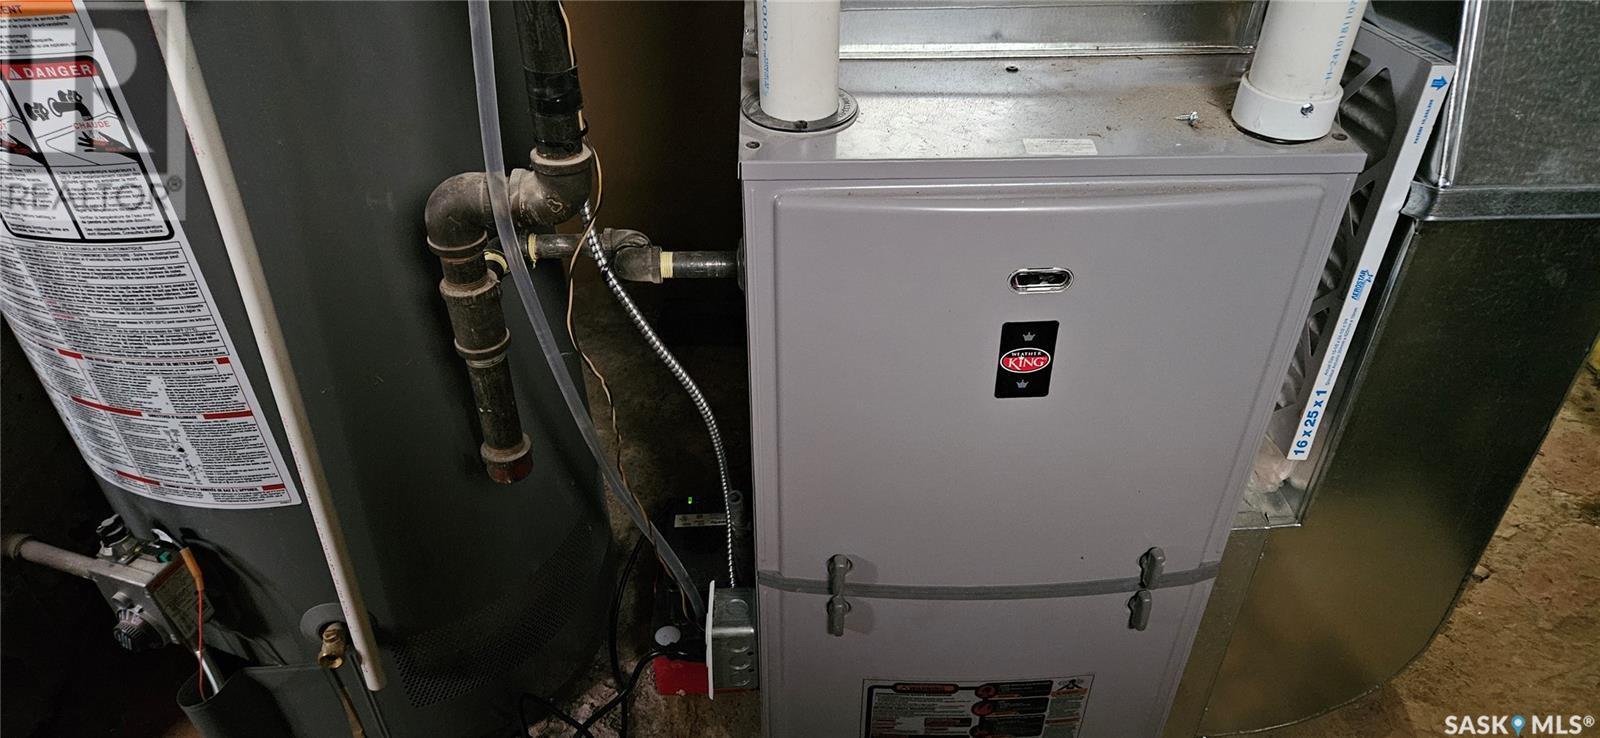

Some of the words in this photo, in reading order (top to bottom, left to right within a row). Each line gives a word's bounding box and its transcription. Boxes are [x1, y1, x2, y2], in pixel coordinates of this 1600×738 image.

[24, 64, 92, 79] DANGER
[73, 120, 111, 130] CHAUDE
[1351, 269, 1368, 301] AEROSTAR
[1008, 354, 1044, 370] KING
[1294, 440, 1308, 455] 16
[1304, 410, 1318, 427] 25
